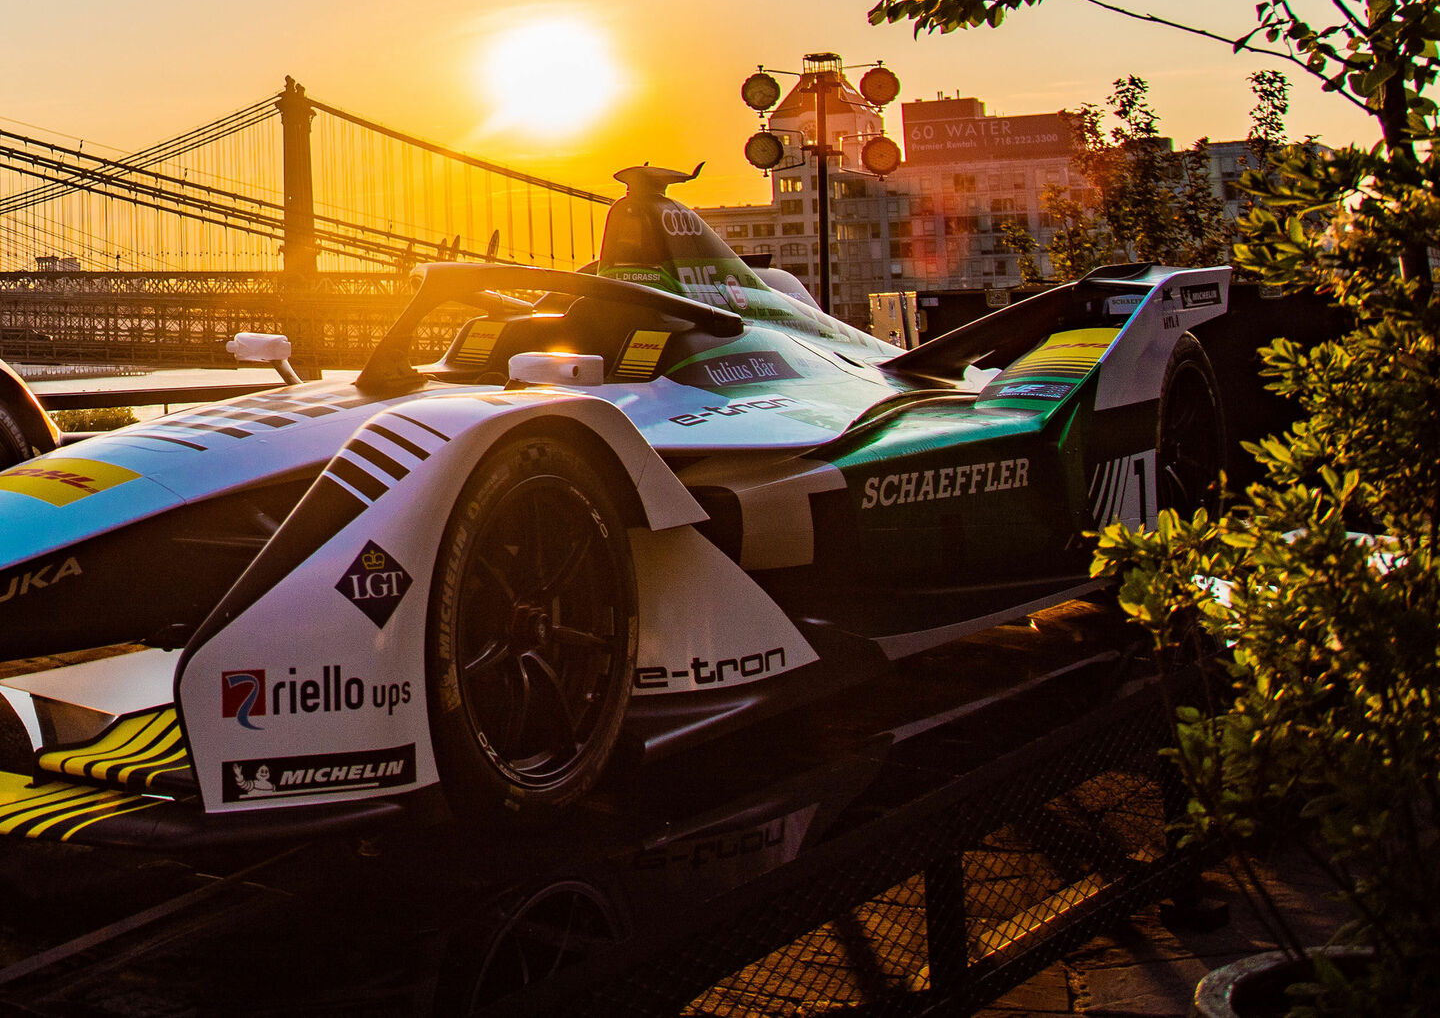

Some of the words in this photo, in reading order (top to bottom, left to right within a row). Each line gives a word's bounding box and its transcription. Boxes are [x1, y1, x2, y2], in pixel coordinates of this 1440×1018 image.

[911, 125, 934, 140] 60
[945, 120, 1012, 137] WATER
[912, 143, 944, 151] Premier
[946, 140, 977, 150] Rentals
[623, 273, 631, 281] DI
[632, 273, 661, 281] GRASSI
[1192, 289, 1218, 301] MICHELIN
[469, 332, 497, 340] DHL
[630, 342, 662, 350] DHL
[704, 361, 752, 387] Julius
[749, 357, 779, 376] Bär
[668, 397, 798, 427] e-tron
[1, 468, 98, 492] DHL
[861, 457, 1030, 509] SCHAEFFLER
[348, 571, 404, 600] LGT
[439, 525, 468, 660] MICHELIN
[634, 646, 786, 689] e-tron
[272, 664, 364, 716] riello
[372, 681, 411, 716] ups
[279, 759, 405, 786] MICHELIN
